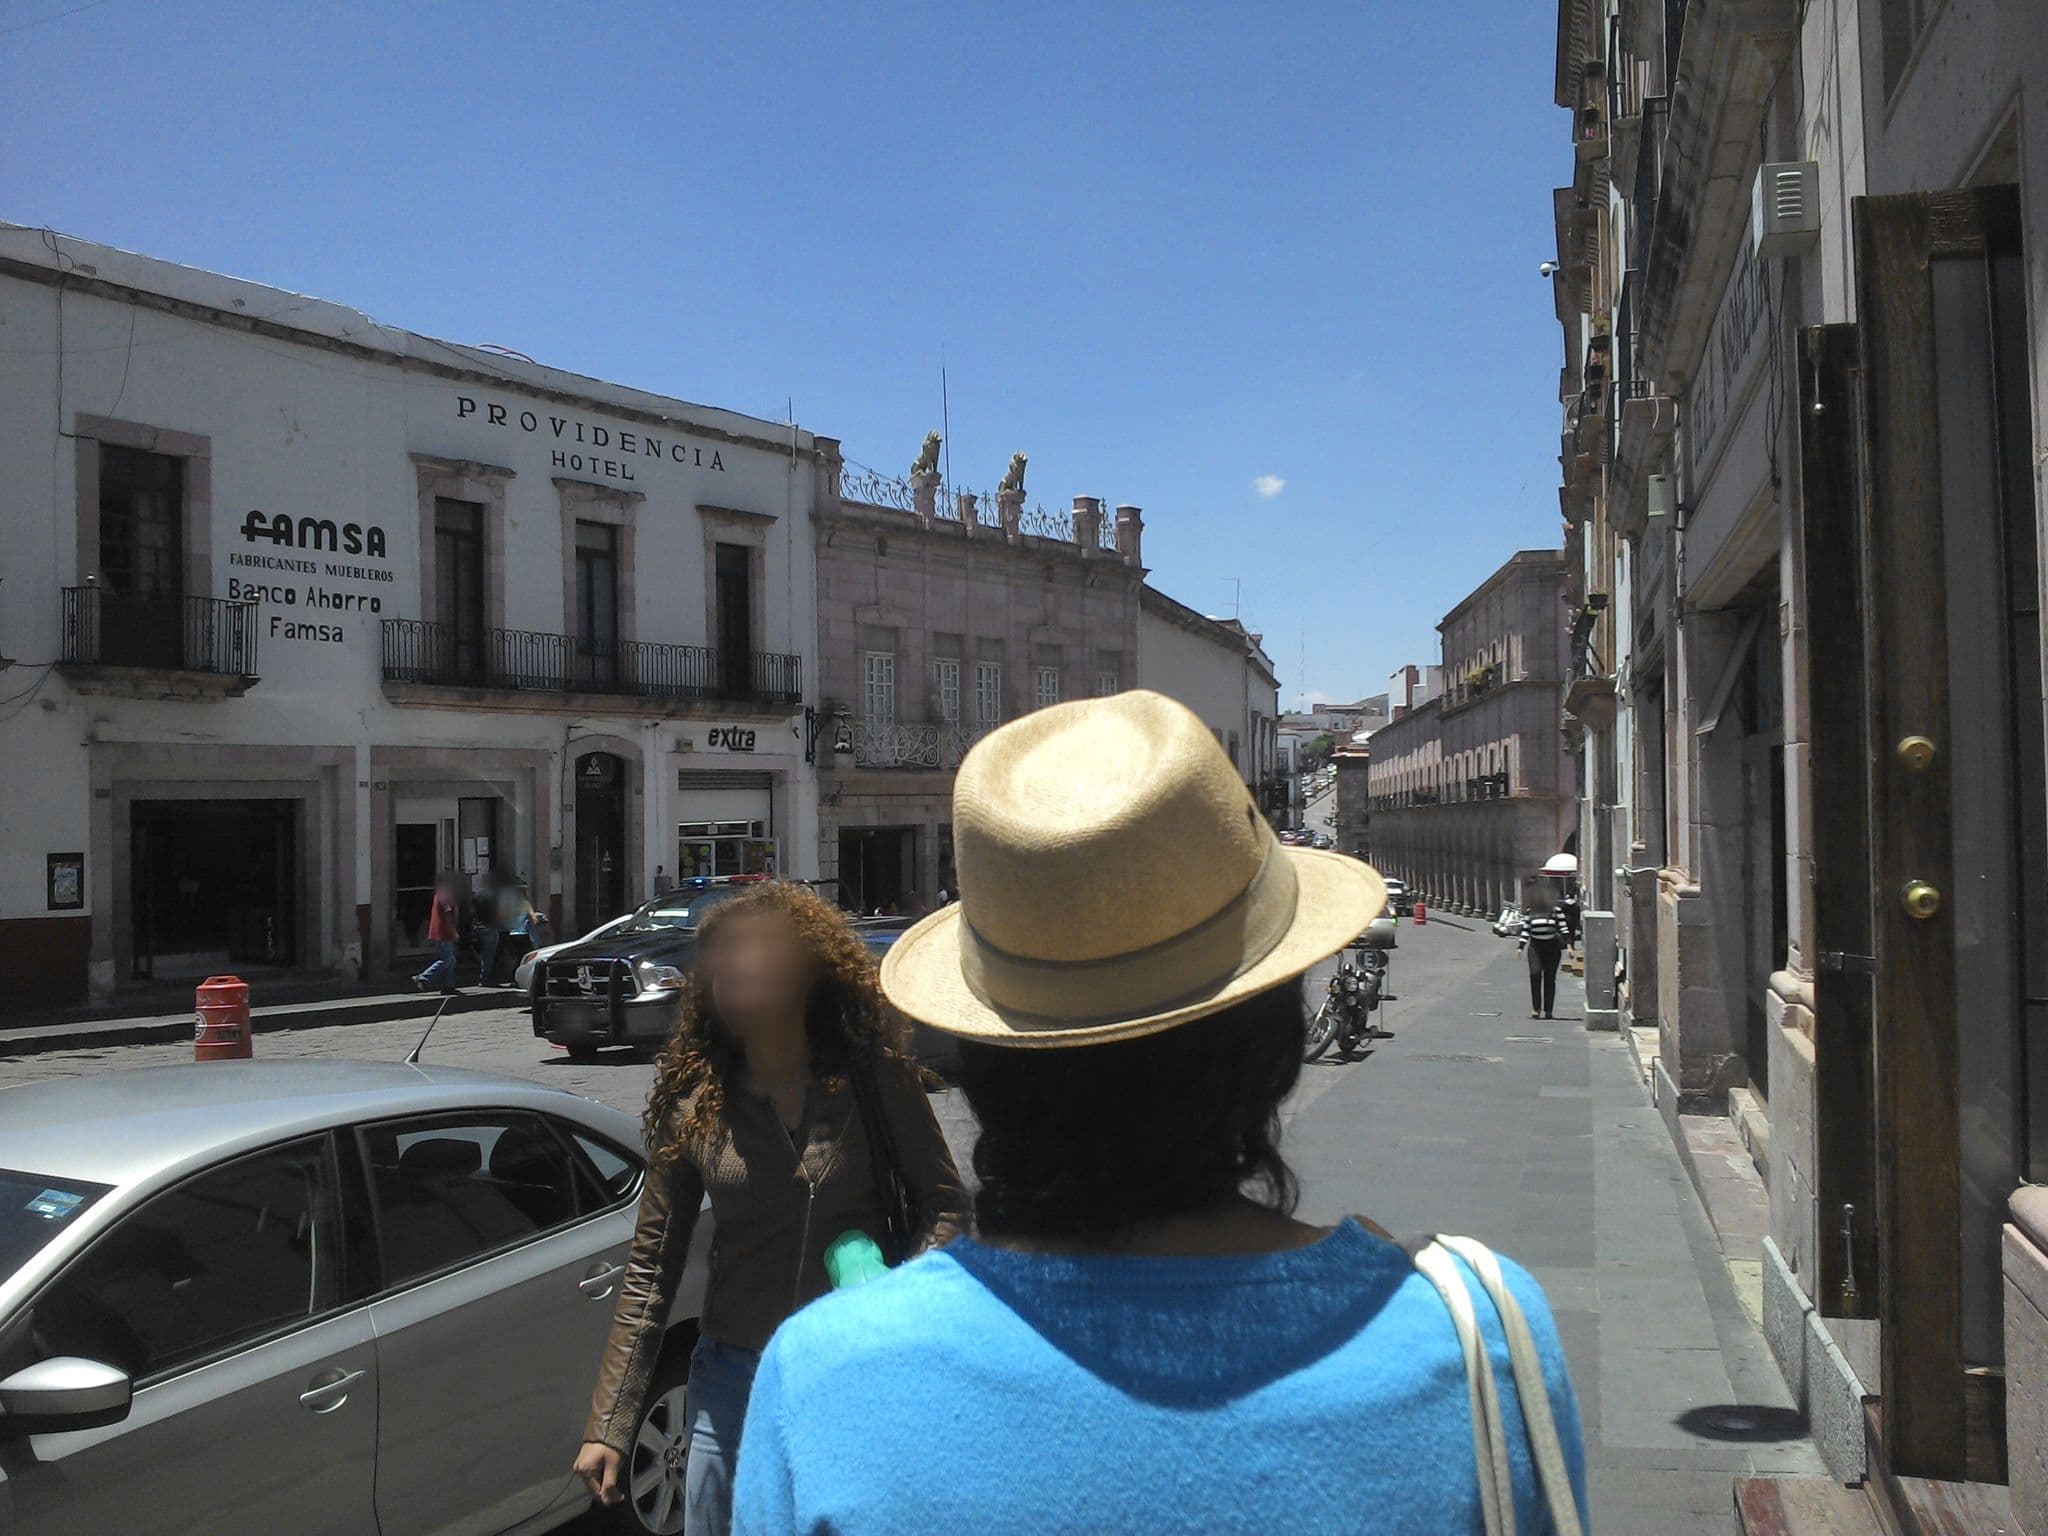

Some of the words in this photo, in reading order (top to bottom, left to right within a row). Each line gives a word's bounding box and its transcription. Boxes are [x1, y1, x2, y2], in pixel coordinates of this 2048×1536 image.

[457, 396, 726, 472] PROVIDENCIA
[551, 450, 635, 481] HOTEL
[229, 553, 317, 574] FABRICANTES
[325, 563, 394, 582] MUEBLEROS
[228, 578, 296, 605] Banco
[305, 586, 381, 614] Ahorro
[270, 616, 344, 643] Famsa
[708, 725, 756, 751] extra
